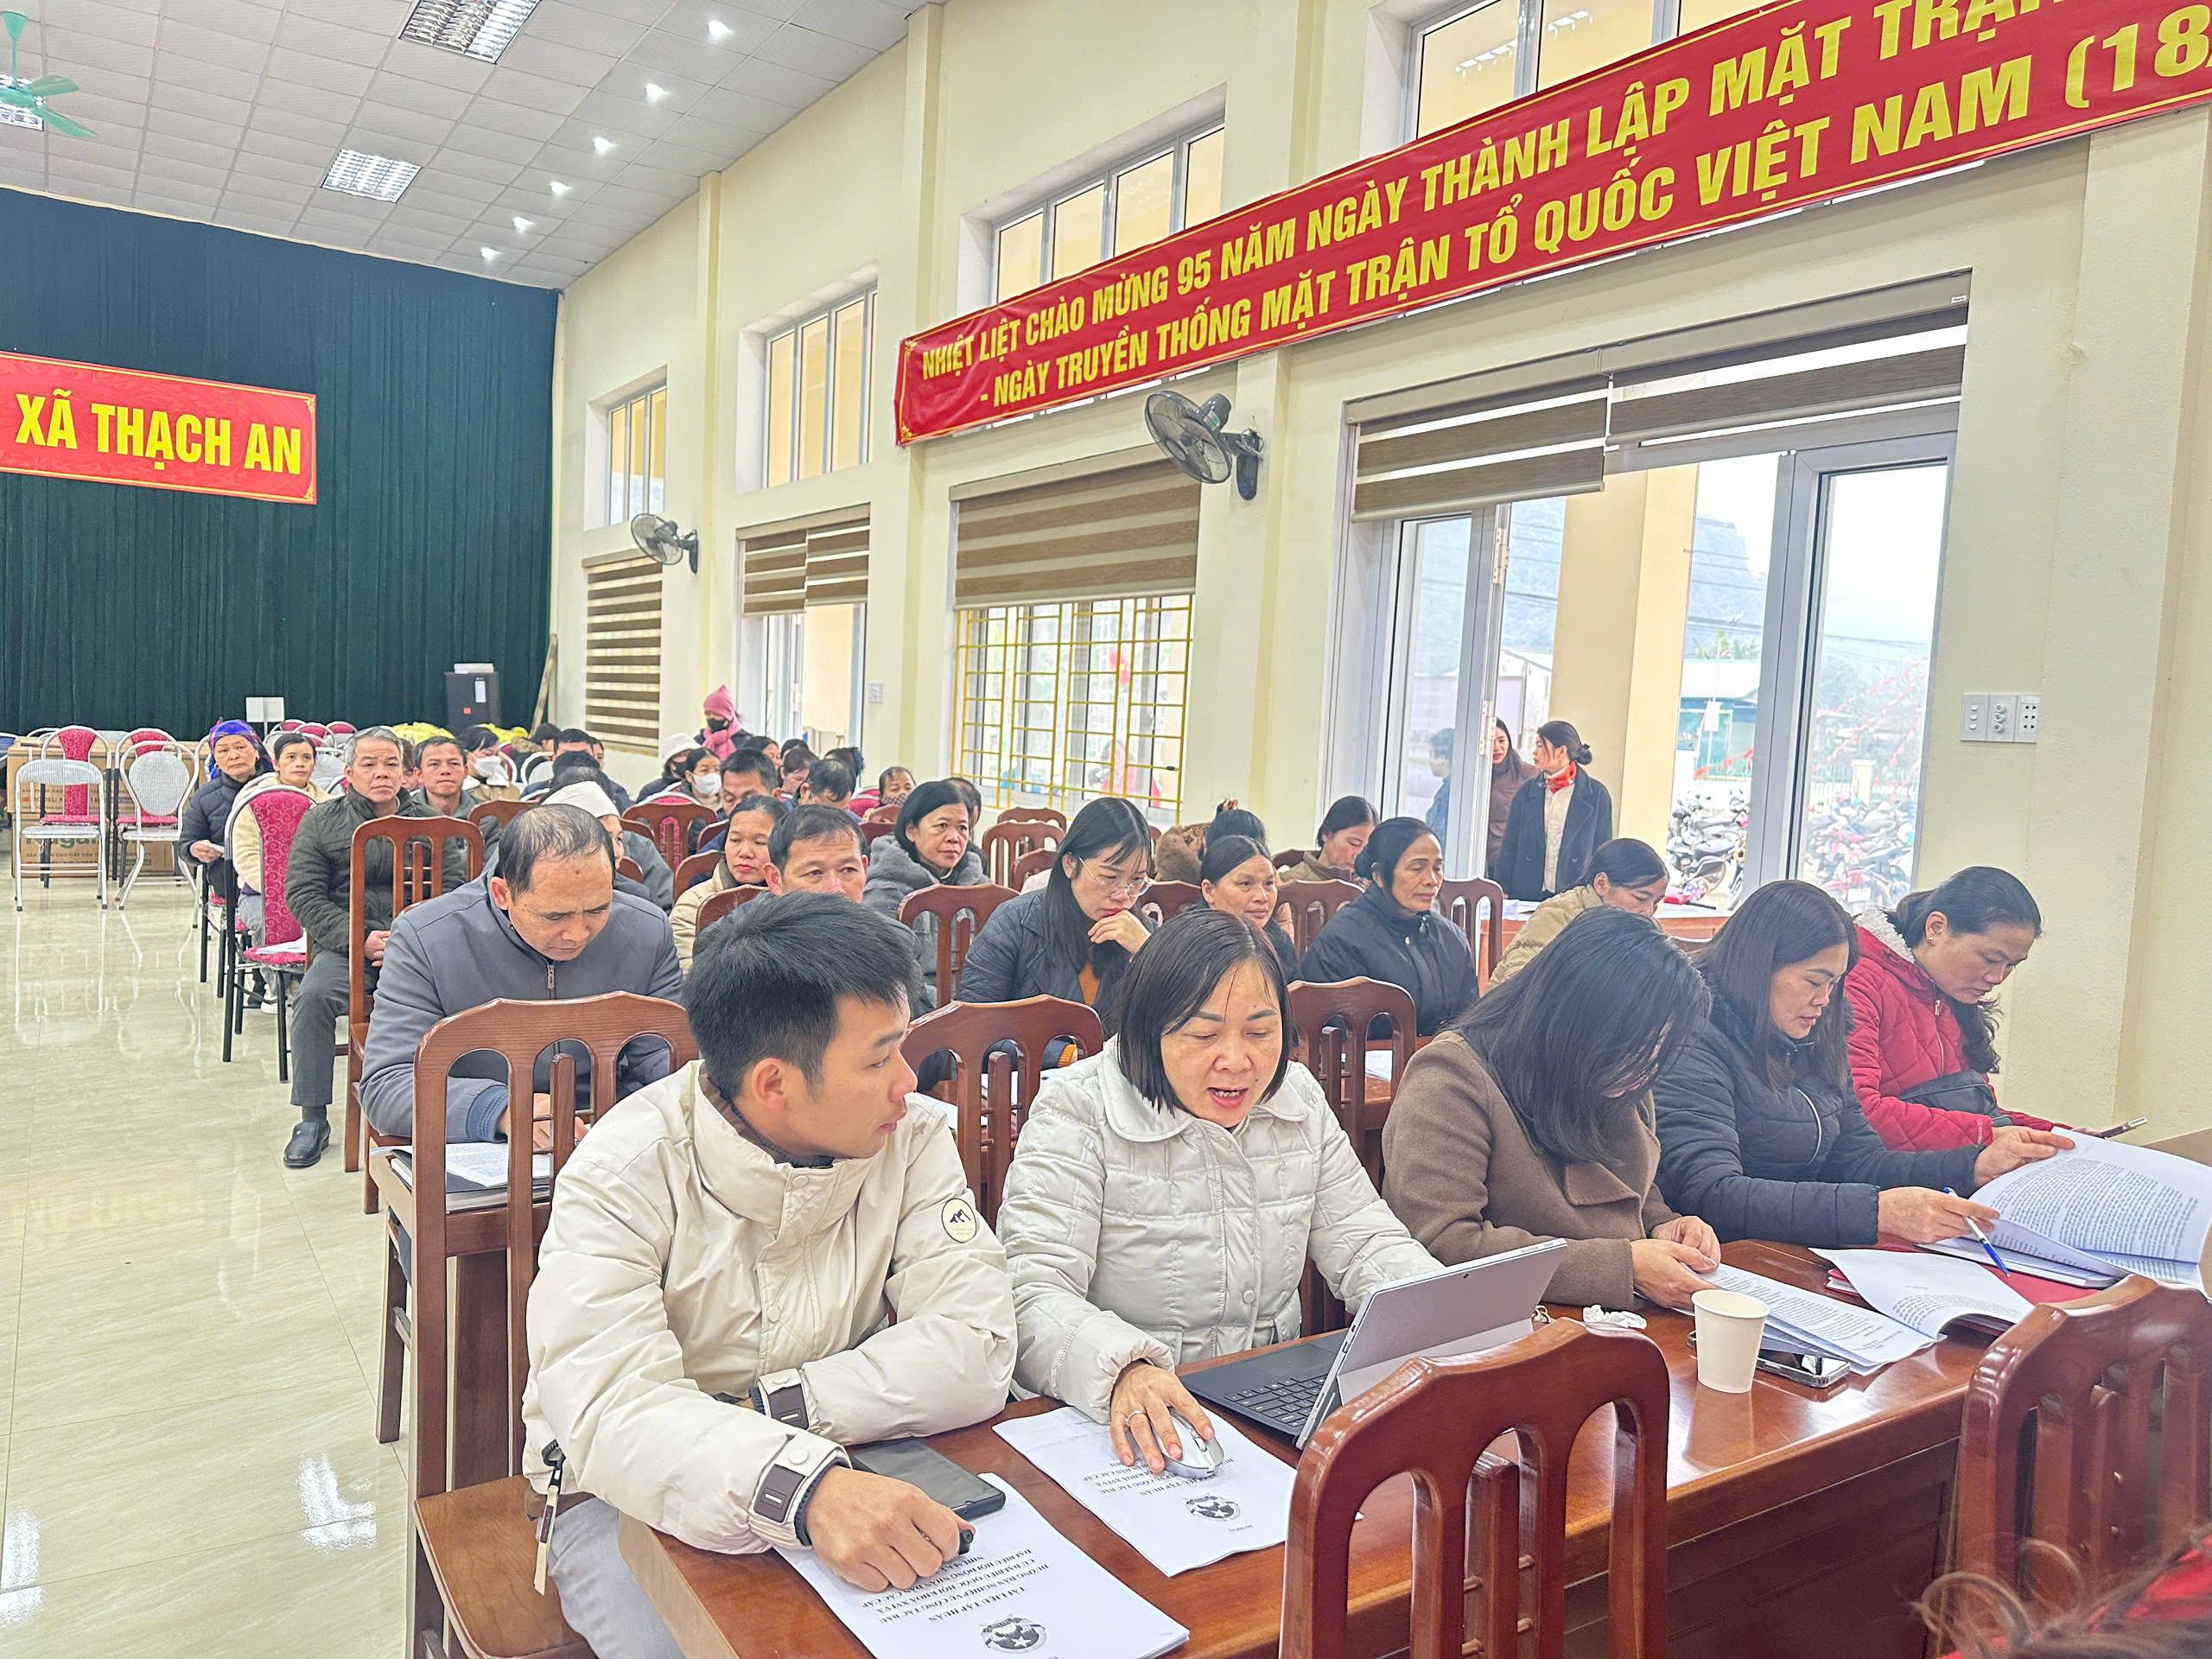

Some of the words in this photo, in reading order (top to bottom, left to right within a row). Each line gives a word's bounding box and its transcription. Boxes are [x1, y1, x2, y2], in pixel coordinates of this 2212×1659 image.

[923, 334, 974, 380] NHIỆT
[979, 317, 1020, 362] LIỆT
[1026, 297, 1084, 346] CHÀO
[1092, 267, 1169, 322] MỪNG
[1179, 251, 1211, 295] 95
[1221, 216, 1296, 280] NĂM
[1307, 177, 1408, 251] NGÀY
[1421, 118, 1570, 213] THÀNH
[1586, 79, 1690, 157] LẬP
[1710, 17, 1851, 116] MẶT
[1873, 0, 2065, 61] TR
[994, 359, 1050, 407] NGÀY
[1056, 325, 1148, 389] TRUYỀN
[1155, 296, 1251, 362] THỐNG
[1262, 271, 1336, 331] MẶT
[1346, 235, 1451, 303] TRẬN
[1464, 194, 1522, 270] TỔ
[1534, 156, 1675, 253] QUỐC
[1697, 117, 1831, 205] VIỆT
[1851, 54, 2034, 164] NAM
[2065, 3, 2212, 109] (18
[15, 388, 79, 450] XÃ
[91, 403, 231, 471] THẠCH
[244, 423, 302, 475] AN
